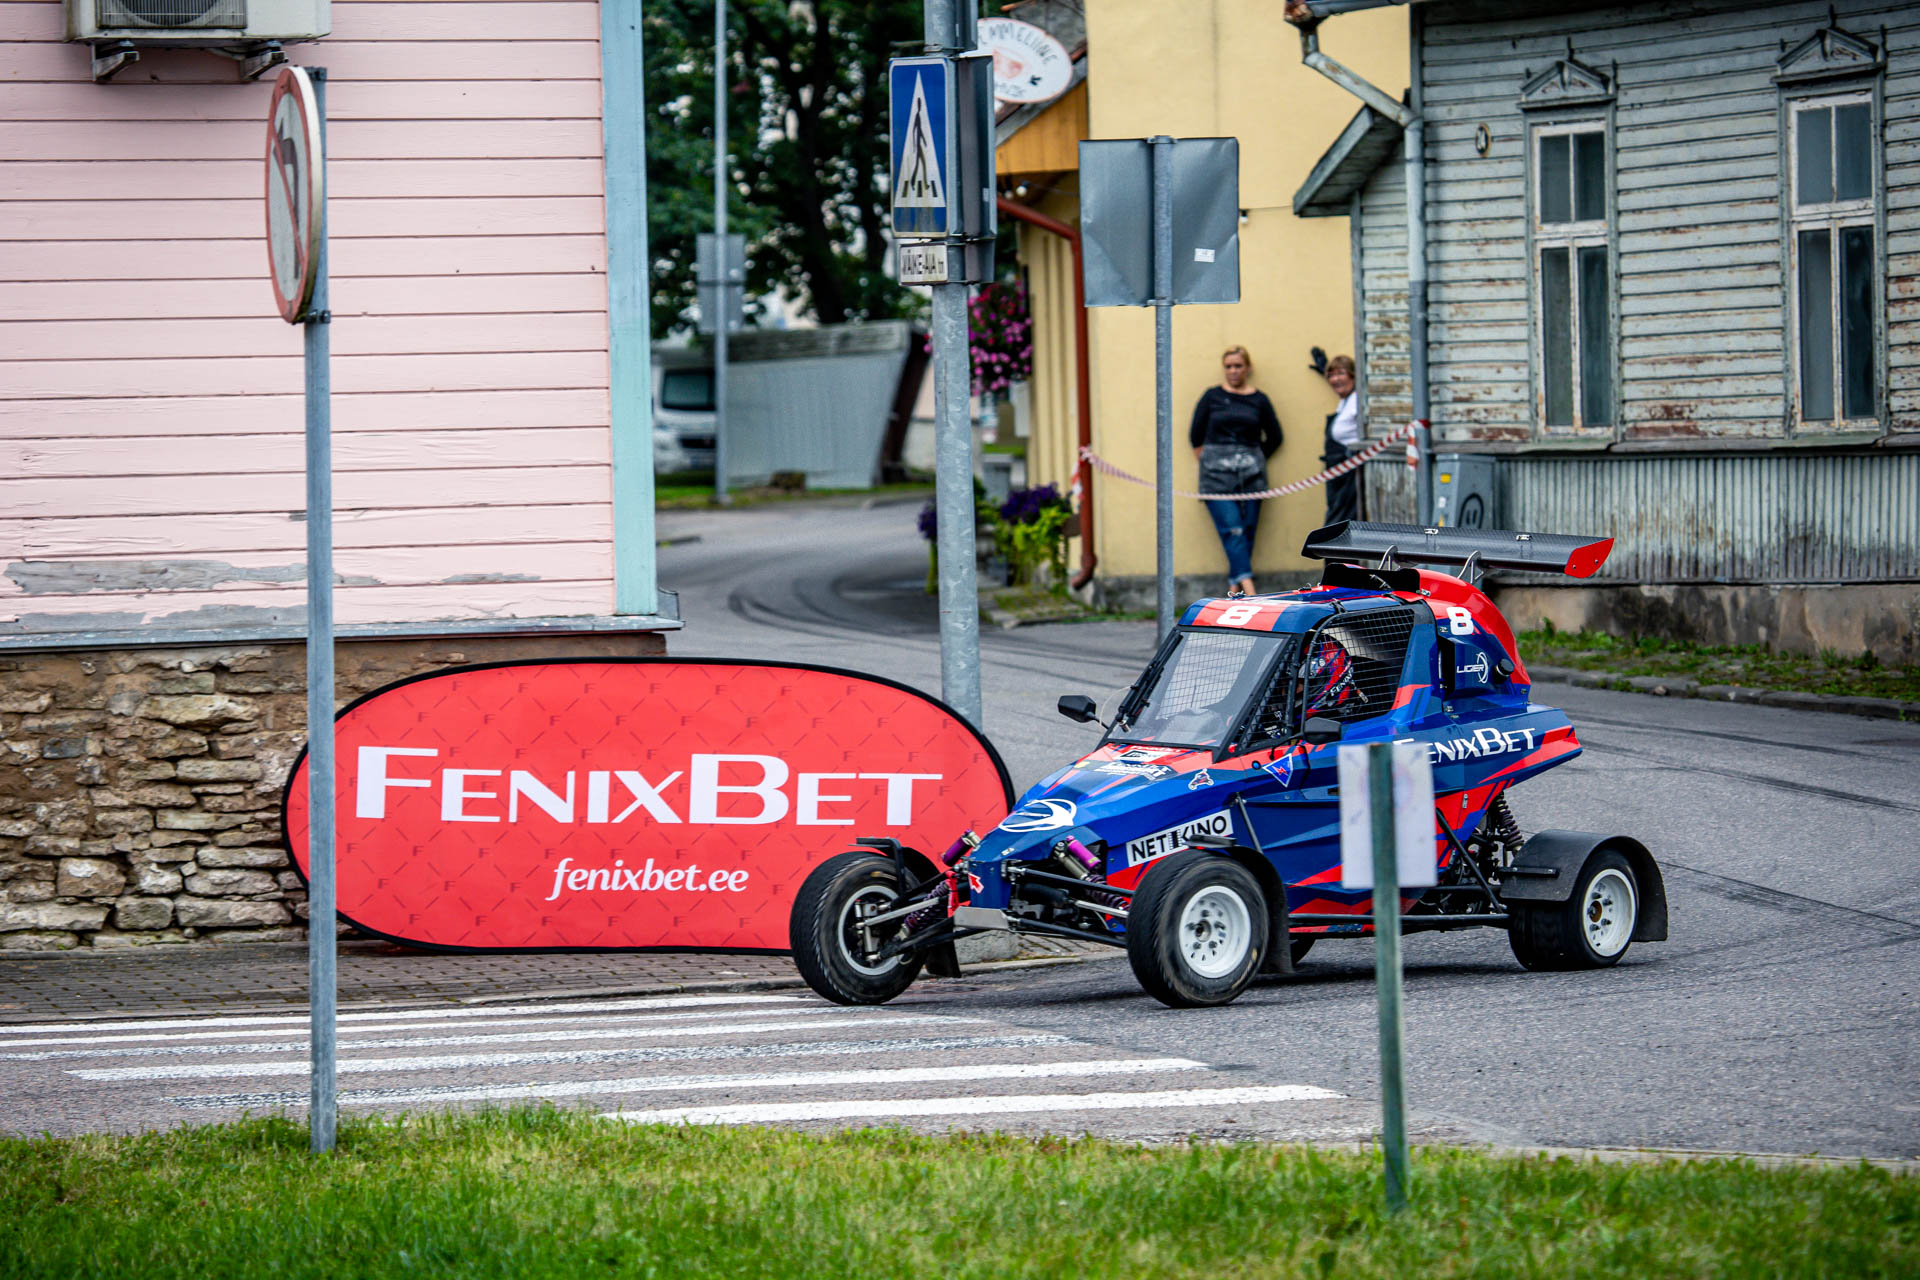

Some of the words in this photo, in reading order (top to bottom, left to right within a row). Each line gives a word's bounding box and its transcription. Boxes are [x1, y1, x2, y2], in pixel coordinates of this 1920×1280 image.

[1216, 605, 1263, 626] 8
[1446, 607, 1474, 635] 8
[1392, 728, 1536, 764] ENIXBET
[355, 745, 943, 826] FENIXBET
[545, 857, 749, 901] fenixbet.ee
